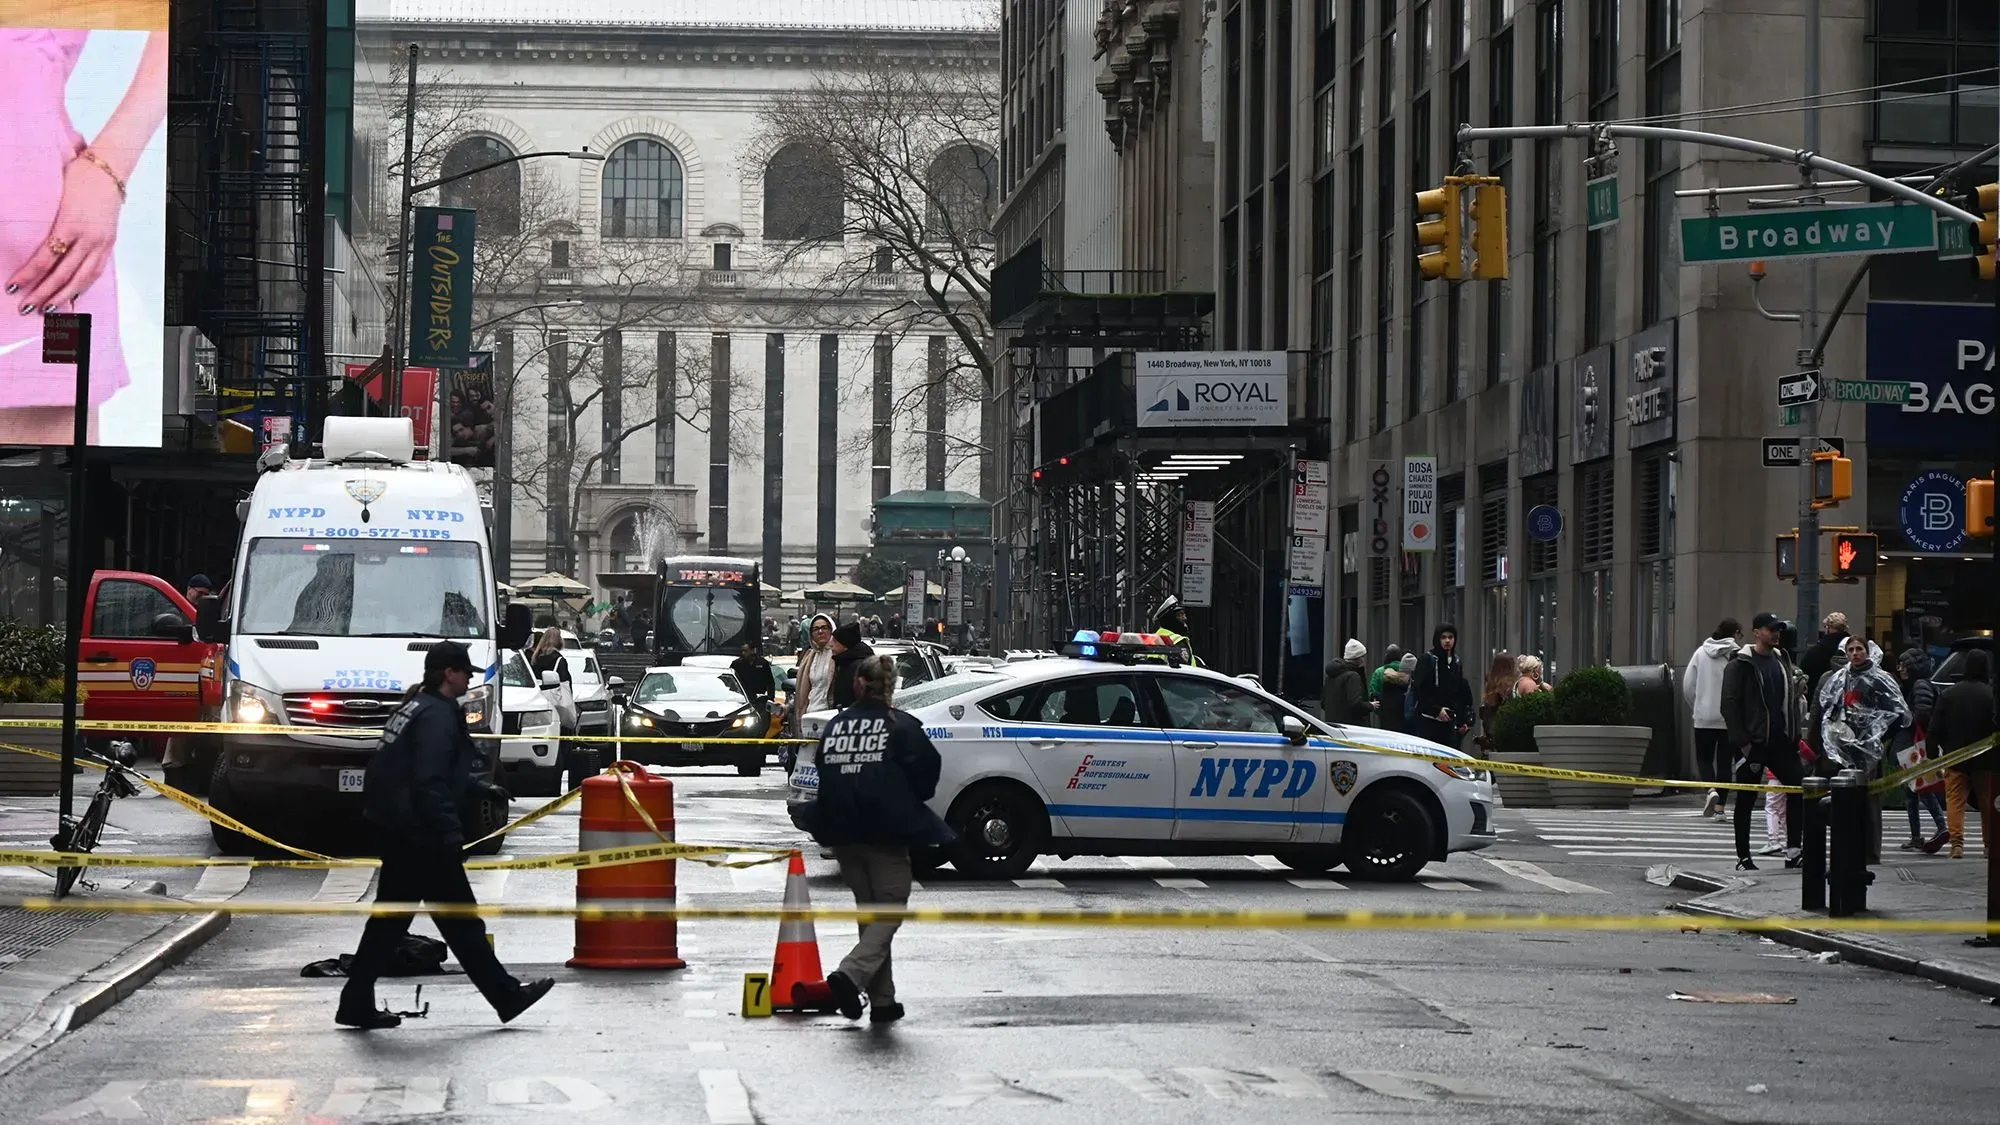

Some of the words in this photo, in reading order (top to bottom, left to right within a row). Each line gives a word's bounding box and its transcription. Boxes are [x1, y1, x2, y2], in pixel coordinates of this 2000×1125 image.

[435, 231, 453, 243] THE
[1719, 220, 1895, 250] Broadway
[1146, 360, 1165, 369] 1440
[1165, 359, 1203, 370] Broadway,
[1203, 359, 1219, 368] New
[1219, 359, 1238, 369] York,
[1239, 359, 1249, 368] NY
[1249, 359, 1272, 368] 10018
[1195, 382, 1278, 403] ROYAL
[1782, 383, 1794, 397] ONE
[1801, 380, 1813, 395] WAY
[1836, 382, 1907, 400] BROADWAY
[1771, 446, 1794, 458] ONE
[1408, 462, 1433, 474] DOSA
[1408, 474, 1433, 484] CHAATS
[1408, 490, 1433, 500] PULAO
[1902, 476, 1925, 503] PARIS
[267, 507, 326, 519] NYPD
[1408, 500, 1432, 515] IDLY
[406, 509, 465, 523] NYPD
[308, 527, 451, 539] 1-800-577-TIPS
[1906, 527, 1942, 551] BAKERY
[679, 569, 707, 581] THE
[707, 570, 744, 583] RIDE
[335, 669, 390, 678] NYPD
[322, 677, 402, 692] POLICE
[831, 718, 887, 736] N.Y.P.D.
[982, 726, 1002, 738] MTS
[823, 732, 890, 754] POLICE
[824, 753, 852, 765] CRIME
[853, 751, 884, 763] SCENE
[1082, 754, 1128, 768] COURTESY
[840, 763, 864, 775] UNIT
[1075, 766, 1150, 780] PROFESSIONALISM
[1066, 778, 1108, 791] RESPECT
[1189, 757, 1317, 799] NYPD
[749, 977, 767, 1007] 7
